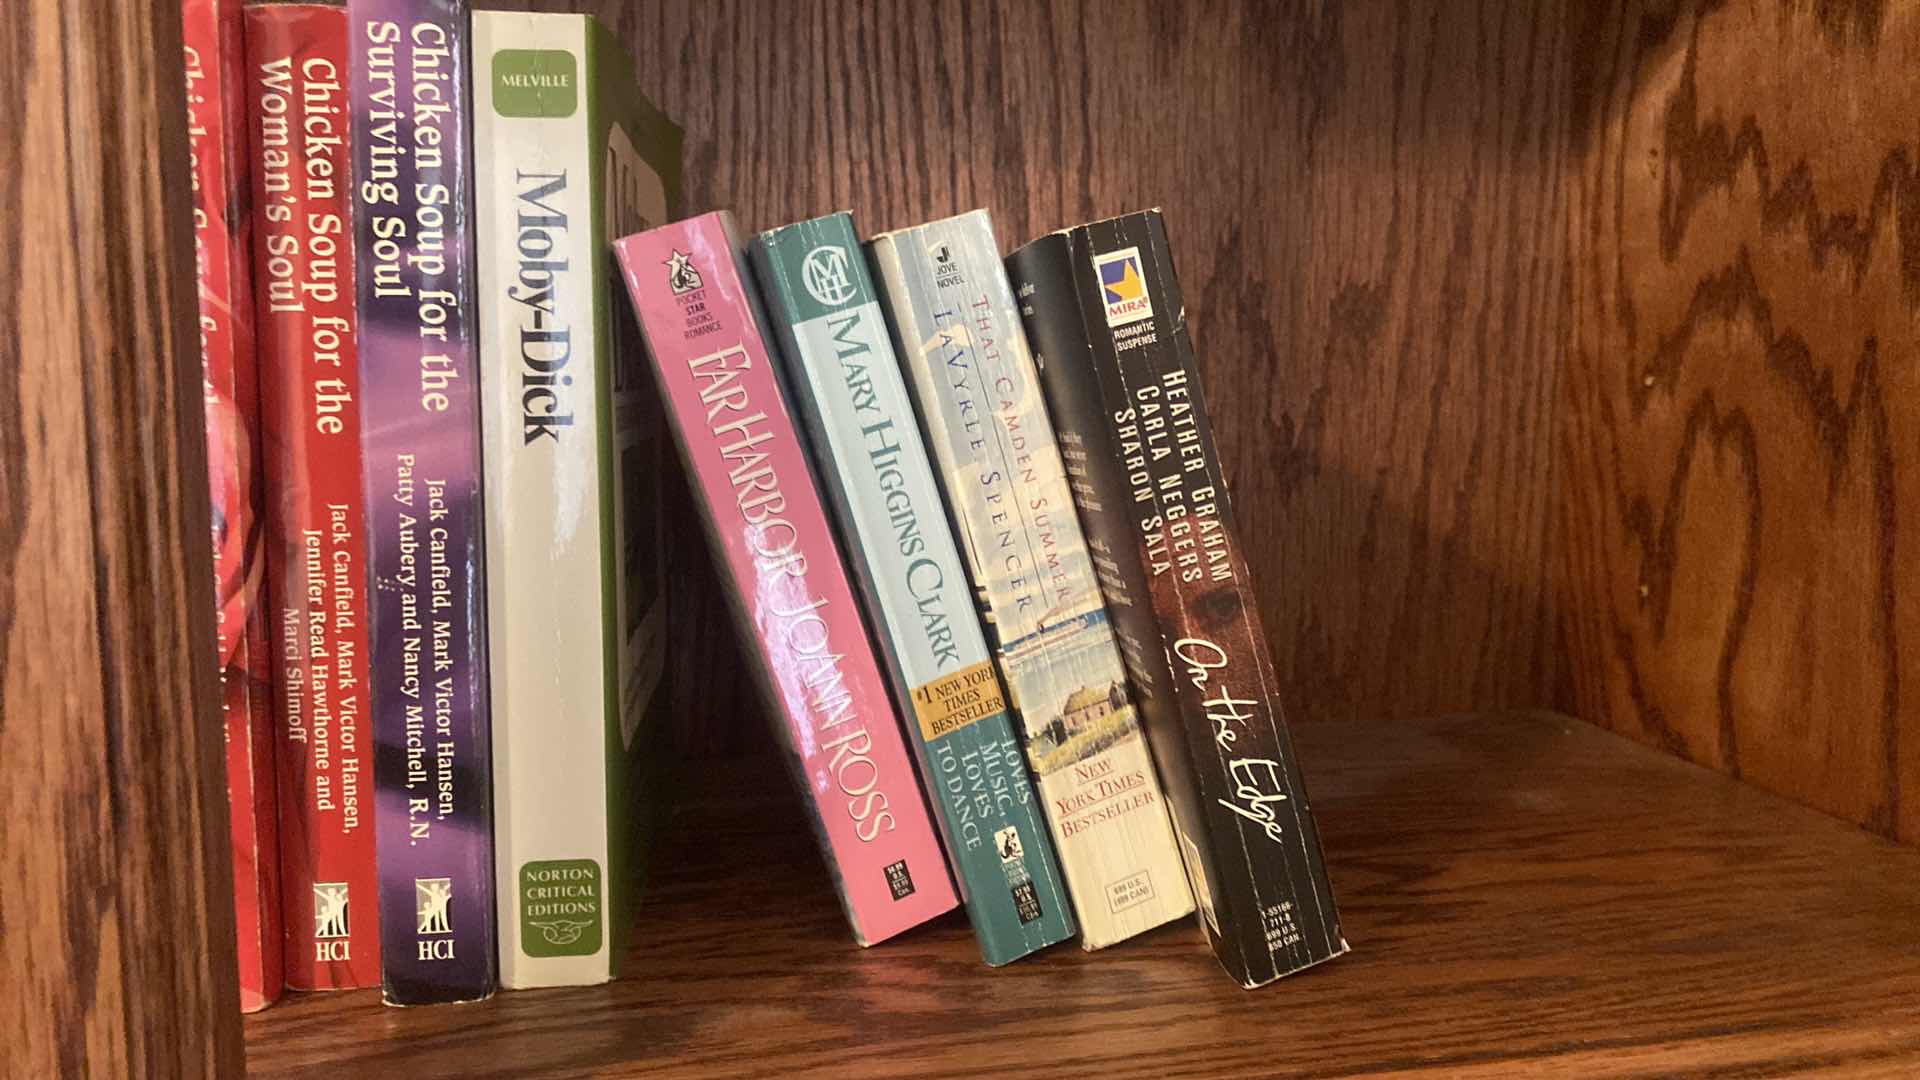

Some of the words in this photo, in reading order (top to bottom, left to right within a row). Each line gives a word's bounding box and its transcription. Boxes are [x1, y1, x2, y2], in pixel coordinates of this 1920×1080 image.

[411, 22, 452, 170] Chicken
[502, 73, 569, 88] MELVILLE
[260, 56, 297, 223] Woman's
[302, 57, 343, 200] Chicken
[362, 20, 406, 206] Surviving
[300, 213, 342, 303] Soup
[372, 216, 412, 298] Soul
[407, 183, 450, 276] Soup
[267, 235, 305, 313] Soul
[676, 290, 707, 305] POCKET
[937, 263, 958, 275] JOVE
[937, 275, 965, 289] NOVEL
[418, 289, 457, 342] for
[507, 168, 574, 446] Moby-Dick
[684, 321, 721, 339] ROMANCE
[686, 303, 705, 315] STAR
[686, 312, 712, 327] BOOKS
[1113, 321, 1156, 340] ROMANTIC
[312, 316, 350, 367] for
[1117, 333, 1157, 352] SUSPENSE
[314, 378, 352, 435] the
[420, 354, 459, 412] the
[972, 294, 1001, 362] THAT
[995, 377, 1037, 484] CAMDEN
[1030, 497, 1072, 601] SUMMER
[1162, 369, 1205, 473] HEATHER
[1191, 485, 1233, 582] GRAHAM
[392, 454, 415, 506] Patty
[424, 478, 449, 522] Jack
[827, 311, 880, 413] MARY
[862, 419, 925, 557] HIGGINS
[906, 558, 960, 671] CLARK
[1114, 408, 1154, 502] SHARON
[1141, 515, 1173, 576] SALA
[1136, 385, 1172, 462] CARLA
[1158, 473, 1203, 583] NEGGERS
[328, 503, 351, 544] Jack
[396, 512, 420, 587] Aubery
[980, 471, 1033, 613] SPENCER
[302, 529, 326, 605] Jennifer
[333, 551, 355, 634] Canfield,
[430, 527, 452, 614] Canfield,
[283, 608, 302, 661] Marci
[308, 611, 329, 658] Read
[401, 593, 422, 630] and
[337, 641, 357, 689] Mark
[400, 638, 421, 699] Nancy
[432, 621, 454, 672] Mark
[286, 667, 307, 744] Shimoff
[311, 665, 333, 770] Hawthorne
[435, 677, 454, 736] Victor
[932, 696, 1003, 735] BESTSELLER
[935, 680, 961, 700] NEW
[944, 688, 981, 712] TIMES
[339, 696, 357, 753] Victor
[405, 705, 428, 789] Mitchell,
[1174, 638, 1228, 692] On
[1217, 758, 1287, 844] Edge
[316, 775, 336, 811] and
[342, 758, 359, 834] Hansen,
[437, 742, 454, 820] Hansen,
[821, 727, 895, 842] ROSS
[937, 740, 957, 772] TO
[947, 777, 982, 851] DANCE
[961, 751, 994, 818] LOVES
[1000, 739, 1030, 804] LOVES
[1056, 793, 1095, 816] YORK
[1097, 770, 1146, 796] TIMES
[1074, 758, 1113, 780] NEW
[409, 798, 430, 846] R.N.
[1060, 791, 1155, 839] BESTSELLER
[527, 869, 594, 882] NORTON
[527, 885, 595, 900] CRITICAL
[527, 902, 596, 916] EDITIONS
[315, 941, 351, 961] HCI
[417, 939, 455, 960] HCI
